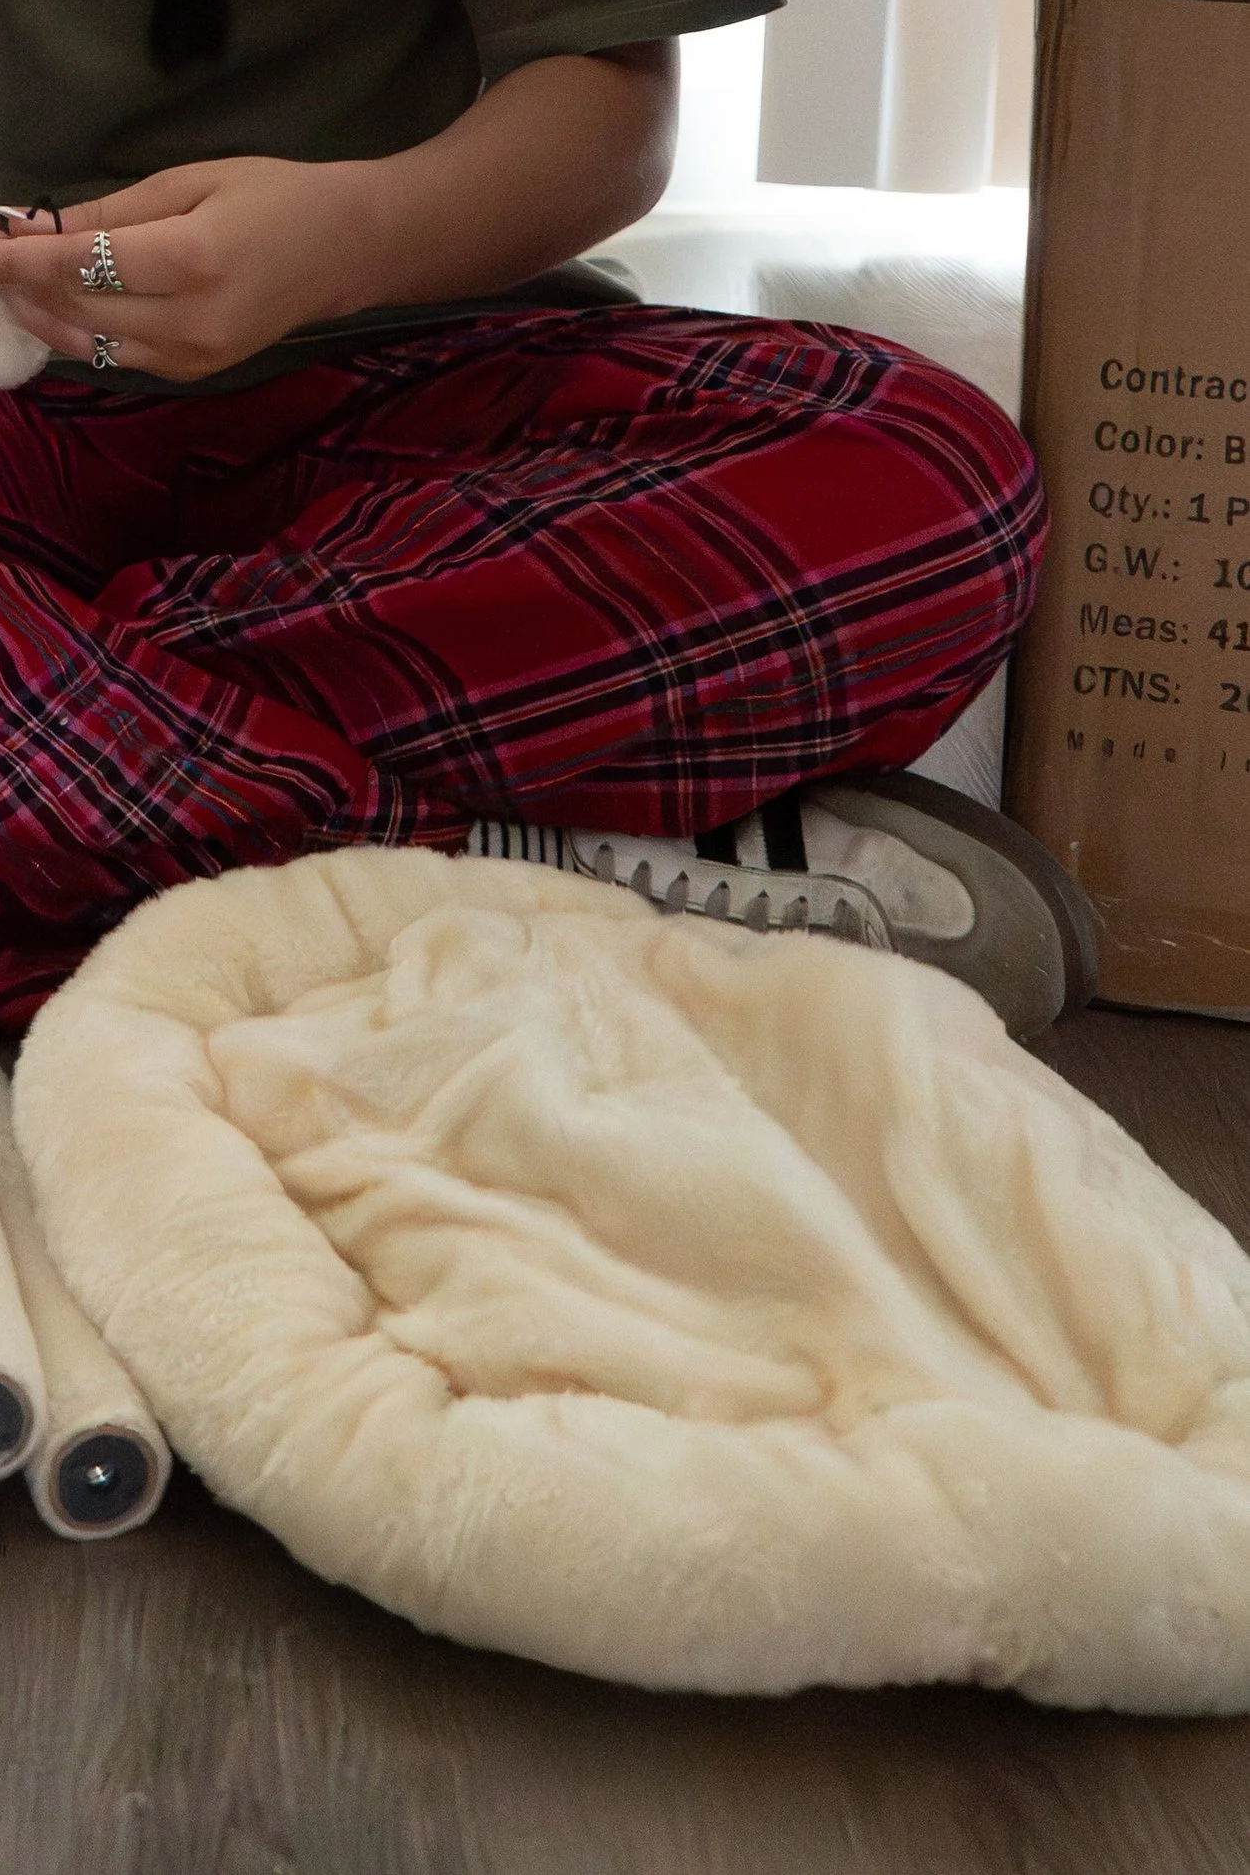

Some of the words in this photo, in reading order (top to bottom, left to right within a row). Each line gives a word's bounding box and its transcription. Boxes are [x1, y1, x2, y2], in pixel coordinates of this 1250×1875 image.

[1094, 420, 1204, 461] Color:
[1088, 481, 1172, 524] Qty.:
[1187, 492, 1211, 524] 1
[1079, 602, 1189, 645] Meas:
[1073, 664, 1182, 705] CTNS:
[1218, 682, 1250, 714] 2
